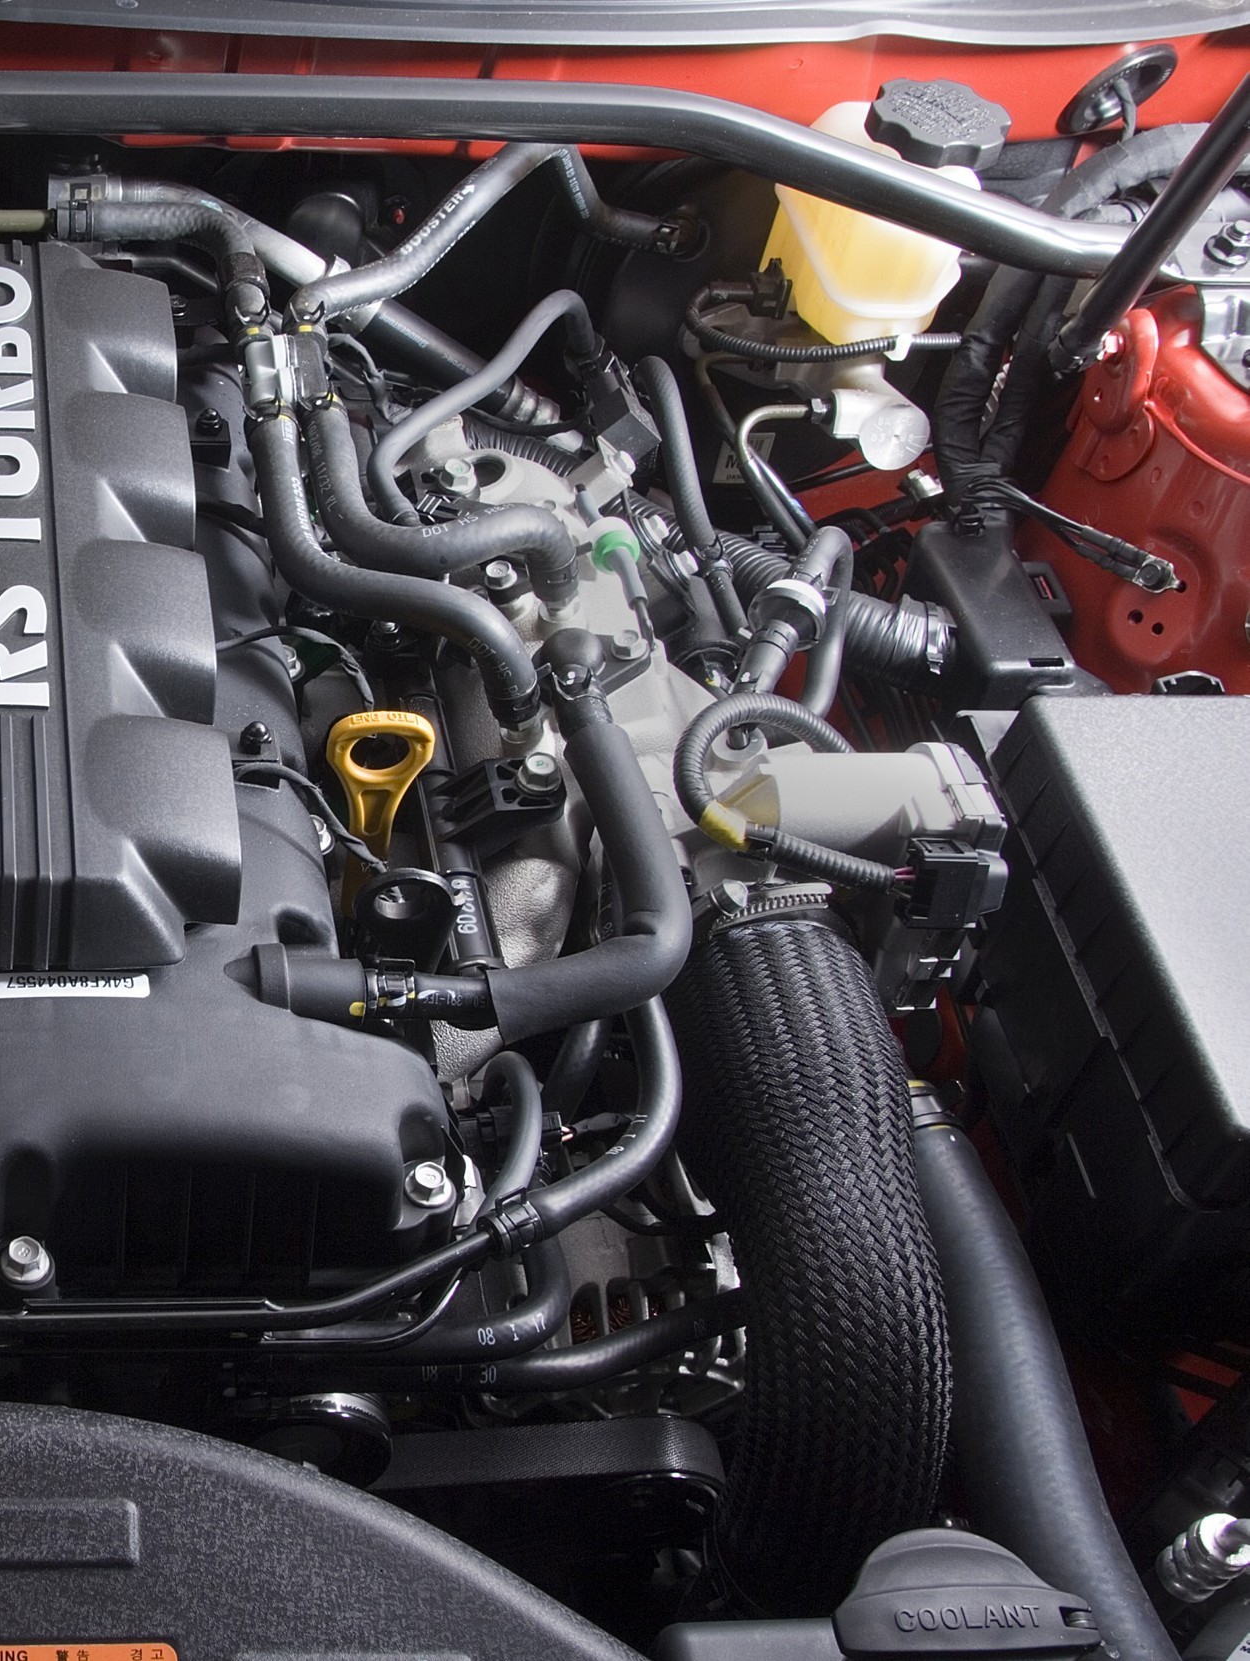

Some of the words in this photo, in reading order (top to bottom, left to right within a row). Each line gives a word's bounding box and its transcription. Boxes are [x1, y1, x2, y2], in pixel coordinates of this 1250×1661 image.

[400, 191, 464, 254] BOOSTER
[422, 523, 450, 538] DOT
[458, 513, 479, 526] HS
[467, 637, 496, 657] DOT
[350, 714, 381, 725] ENG
[387, 712, 415, 723] OIL
[7, 975, 134, 989] G4KF8A044557
[477, 1327, 495, 1346] 08
[533, 1312, 547, 1333] 17
[479, 1365, 497, 1384] 30
[894, 1605, 1040, 1633] COOLANT
